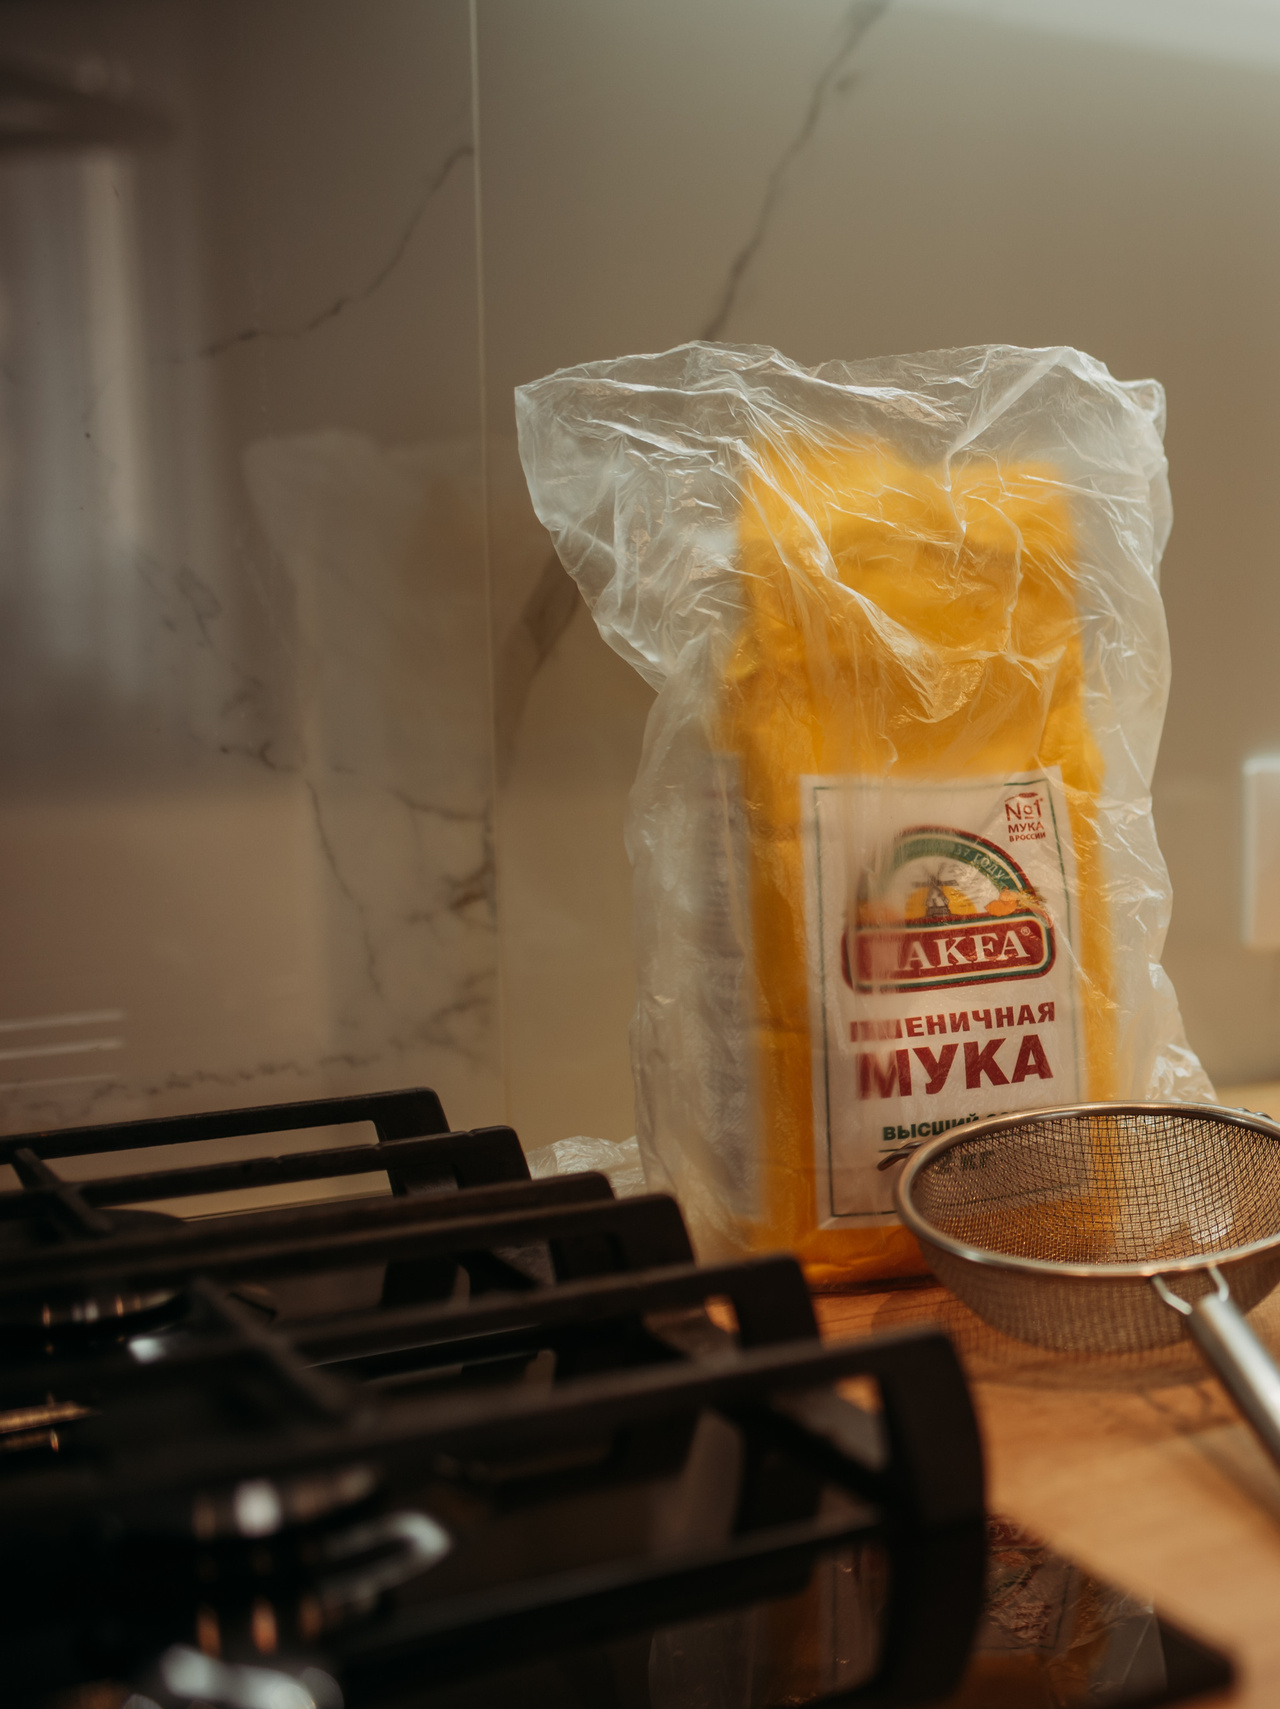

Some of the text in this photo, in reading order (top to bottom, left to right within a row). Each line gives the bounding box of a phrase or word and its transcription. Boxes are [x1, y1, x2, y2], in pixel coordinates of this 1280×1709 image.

[1007, 821, 1045, 833] МУКА
[1015, 832, 1047, 842] РОССИИ
[870, 929, 1031, 972] AKFA
[857, 1034, 1055, 1100] МУКА
